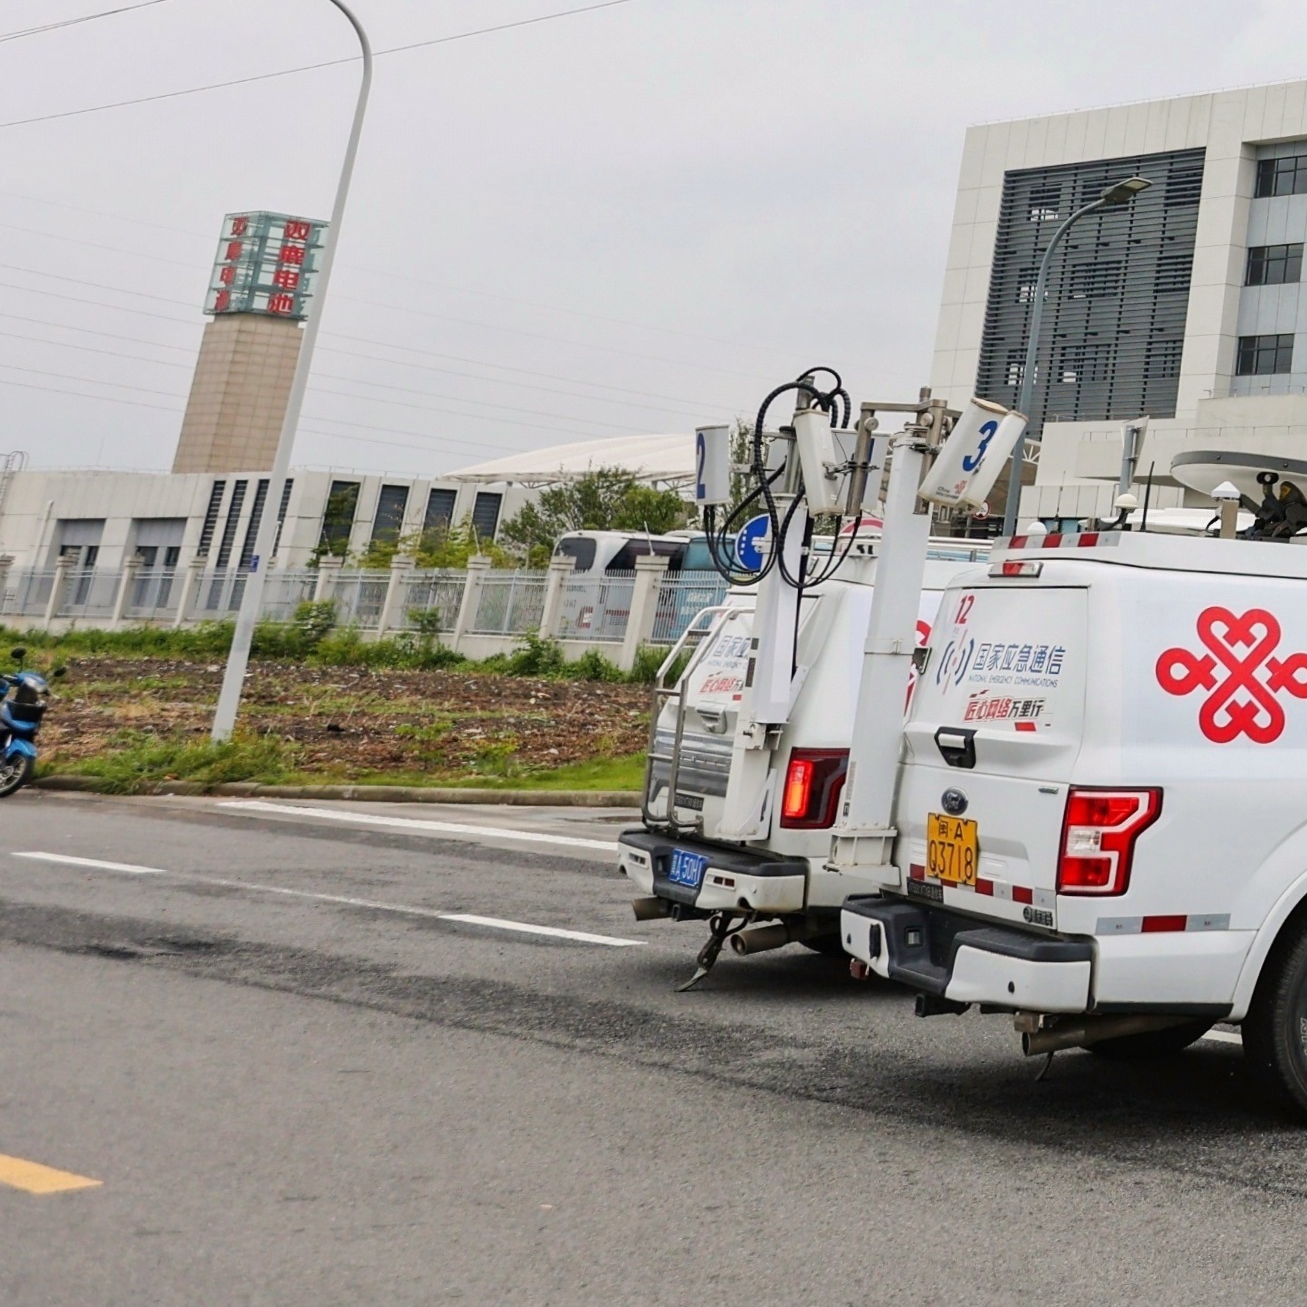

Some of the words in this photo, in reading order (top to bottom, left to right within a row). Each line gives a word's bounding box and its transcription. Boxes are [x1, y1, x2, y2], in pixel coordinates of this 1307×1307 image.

[267, 219, 312, 315] 双鹿电池
[962, 420, 998, 472] 3
[954, 594, 975, 625] 12
[972, 643, 1066, 675] 国家应急通信
[964, 698, 1045, 722] 匠心网络万里行
[928, 839, 974, 880] Q3718
